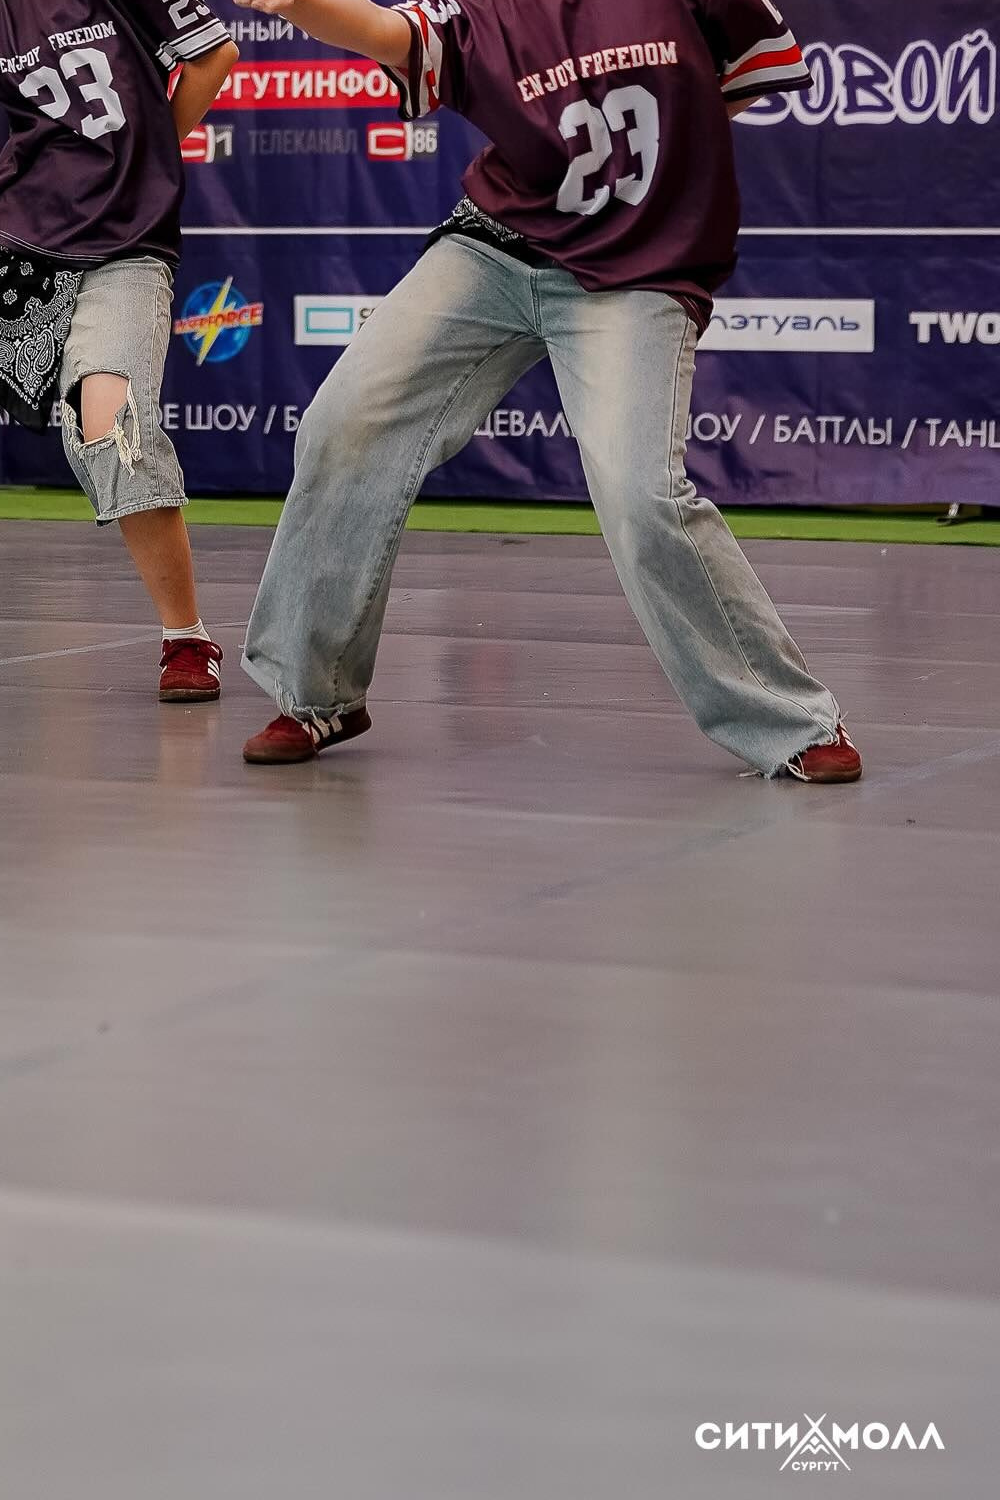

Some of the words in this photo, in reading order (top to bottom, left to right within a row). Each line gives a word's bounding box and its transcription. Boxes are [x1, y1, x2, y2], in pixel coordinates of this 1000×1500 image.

[48, 20, 117, 51] FREEDOM
[517, 58, 579, 102] ENJOY
[579, 41, 678, 78] FREEDOM
[731, 28, 997, 126] ОВОЙ
[249, 129, 359, 156] ТЕЛЕКАНАЛ
[556, 85, 660, 216] 23
[185, 404, 257, 431] ШОУ
[473, 409, 572, 439] ЦЕВАЛ
[773, 414, 892, 445] БАТТЛЫ
